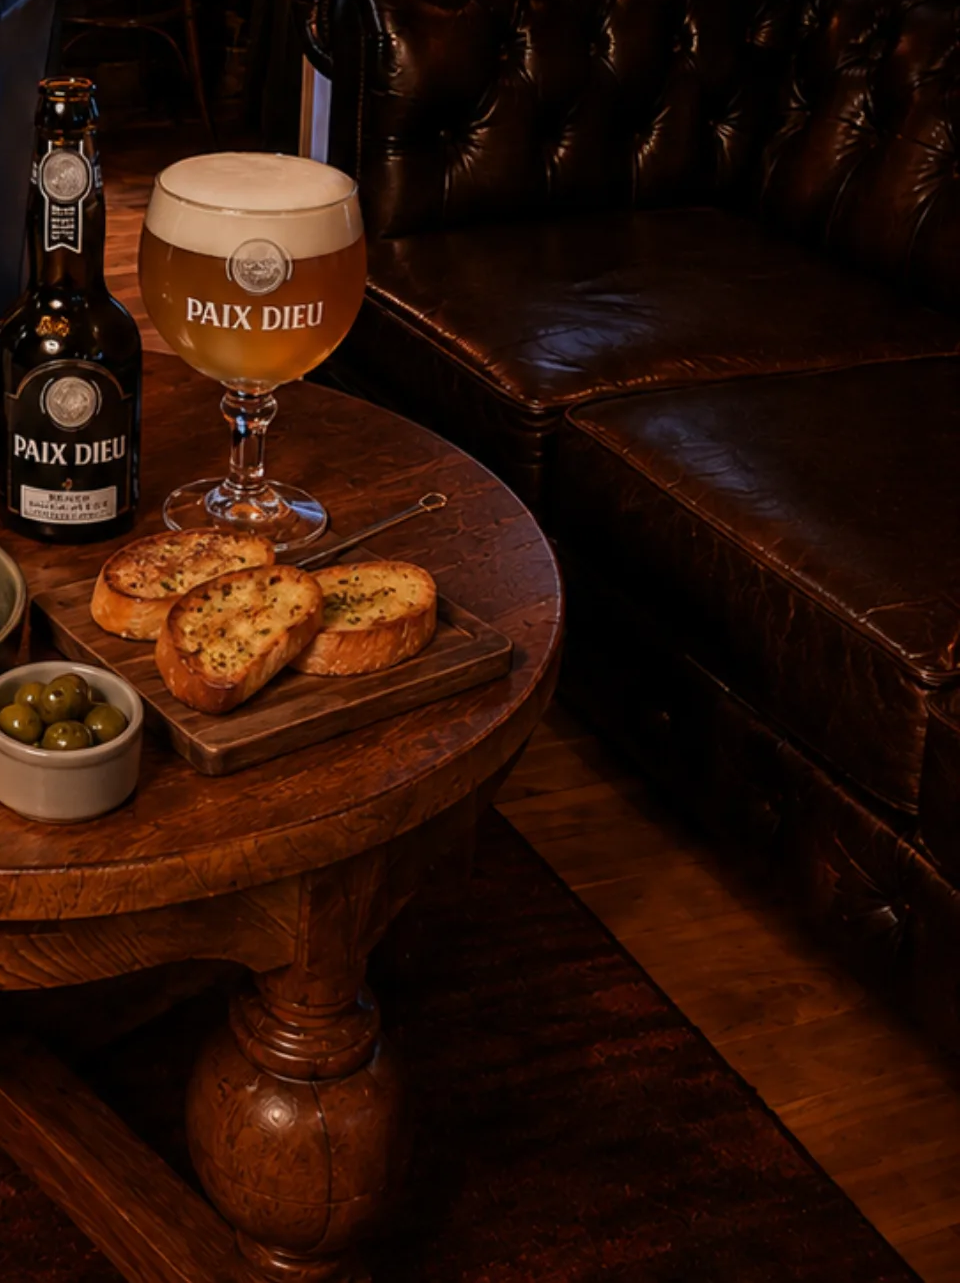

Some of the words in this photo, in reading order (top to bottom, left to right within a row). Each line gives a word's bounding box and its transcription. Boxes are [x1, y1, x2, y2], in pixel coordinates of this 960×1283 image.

[186, 297, 252, 330] PAIX
[261, 301, 324, 331] DIEU
[14, 434, 68, 466] PAIX
[74, 434, 126, 465] DIEU
